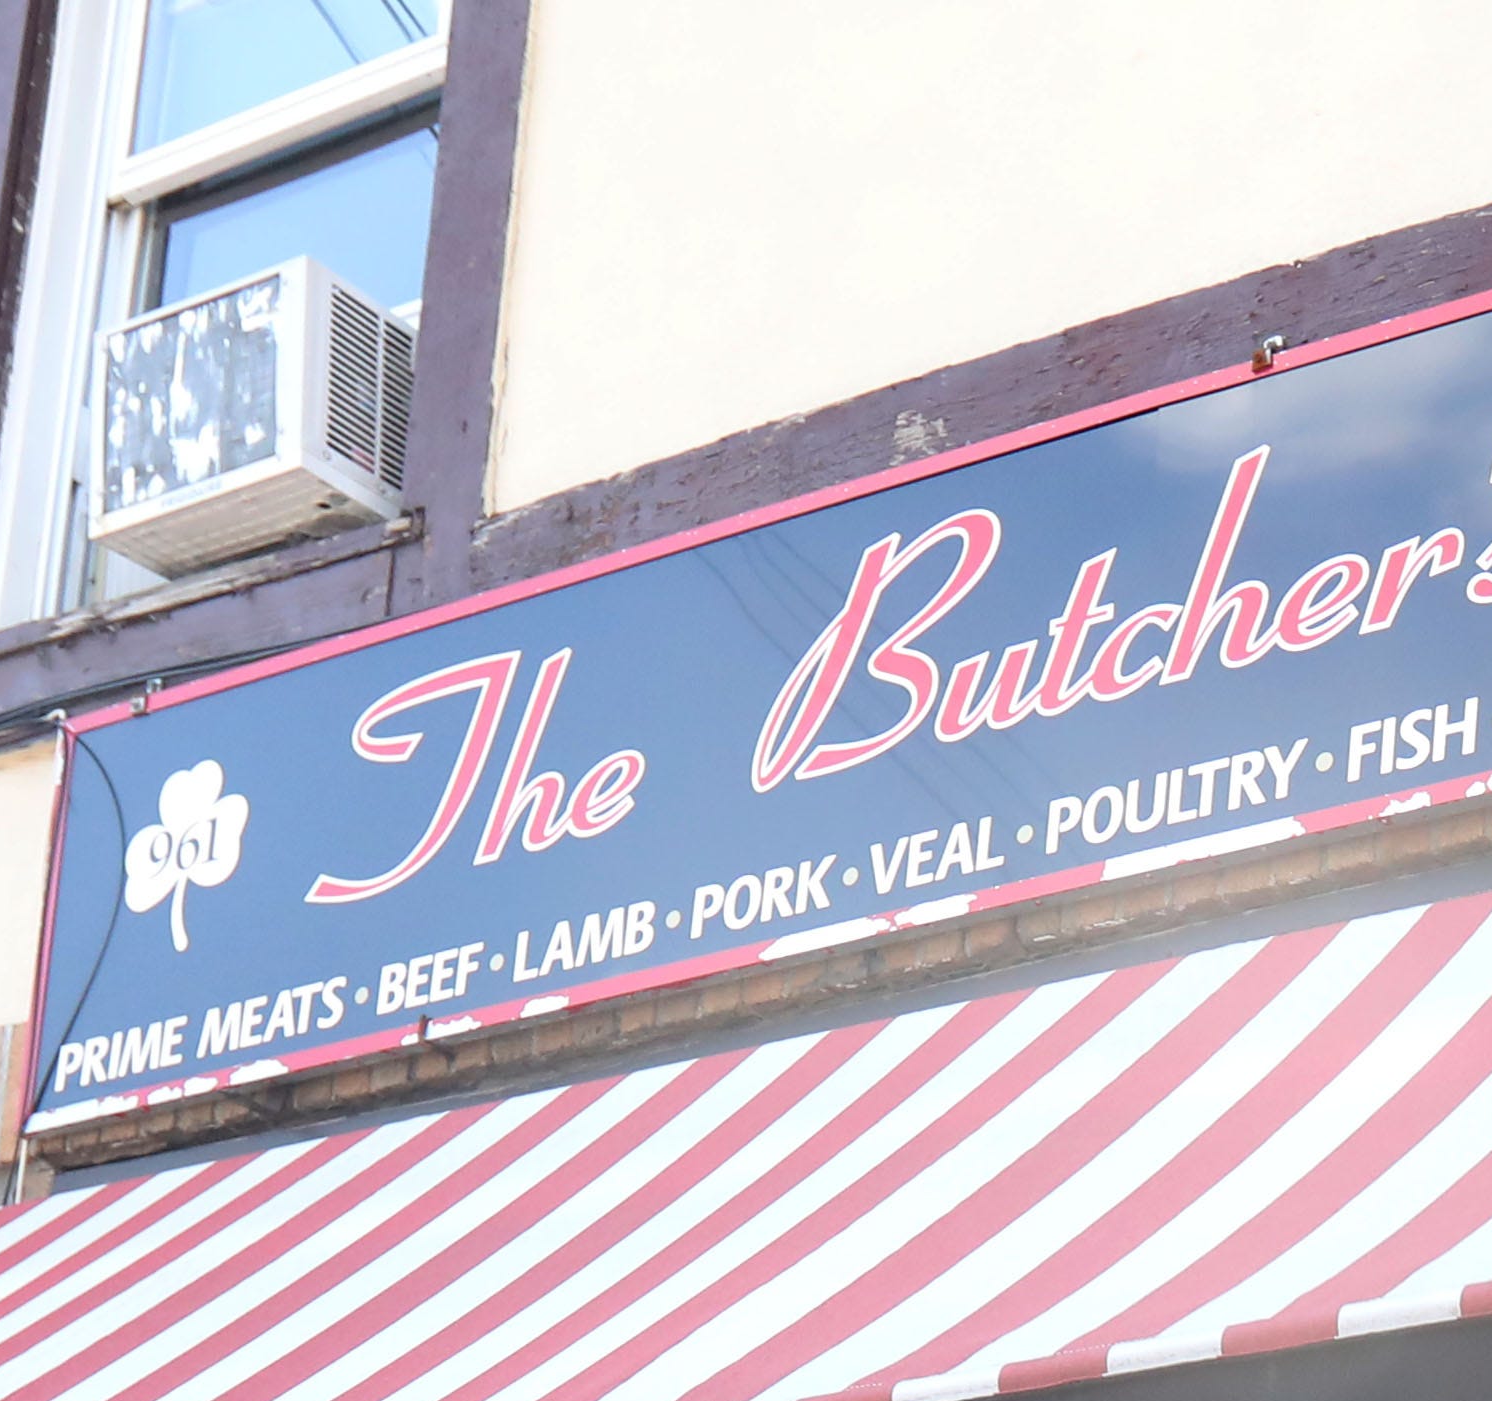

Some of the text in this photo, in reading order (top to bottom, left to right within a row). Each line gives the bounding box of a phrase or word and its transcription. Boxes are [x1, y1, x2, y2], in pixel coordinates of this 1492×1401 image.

[55, 1021, 181, 1090] PRIME
[196, 972, 343, 1060] MEATS
[376, 941, 482, 1017] BEEF
[513, 901, 655, 984] LAMB
[689, 856, 836, 941] PORK
[870, 820, 1004, 898] VEAL
[1044, 739, 1310, 857] POULTRY
[1346, 696, 1477, 783] FISH
[148, 815, 222, 876] 961
[305, 647, 646, 905] The
